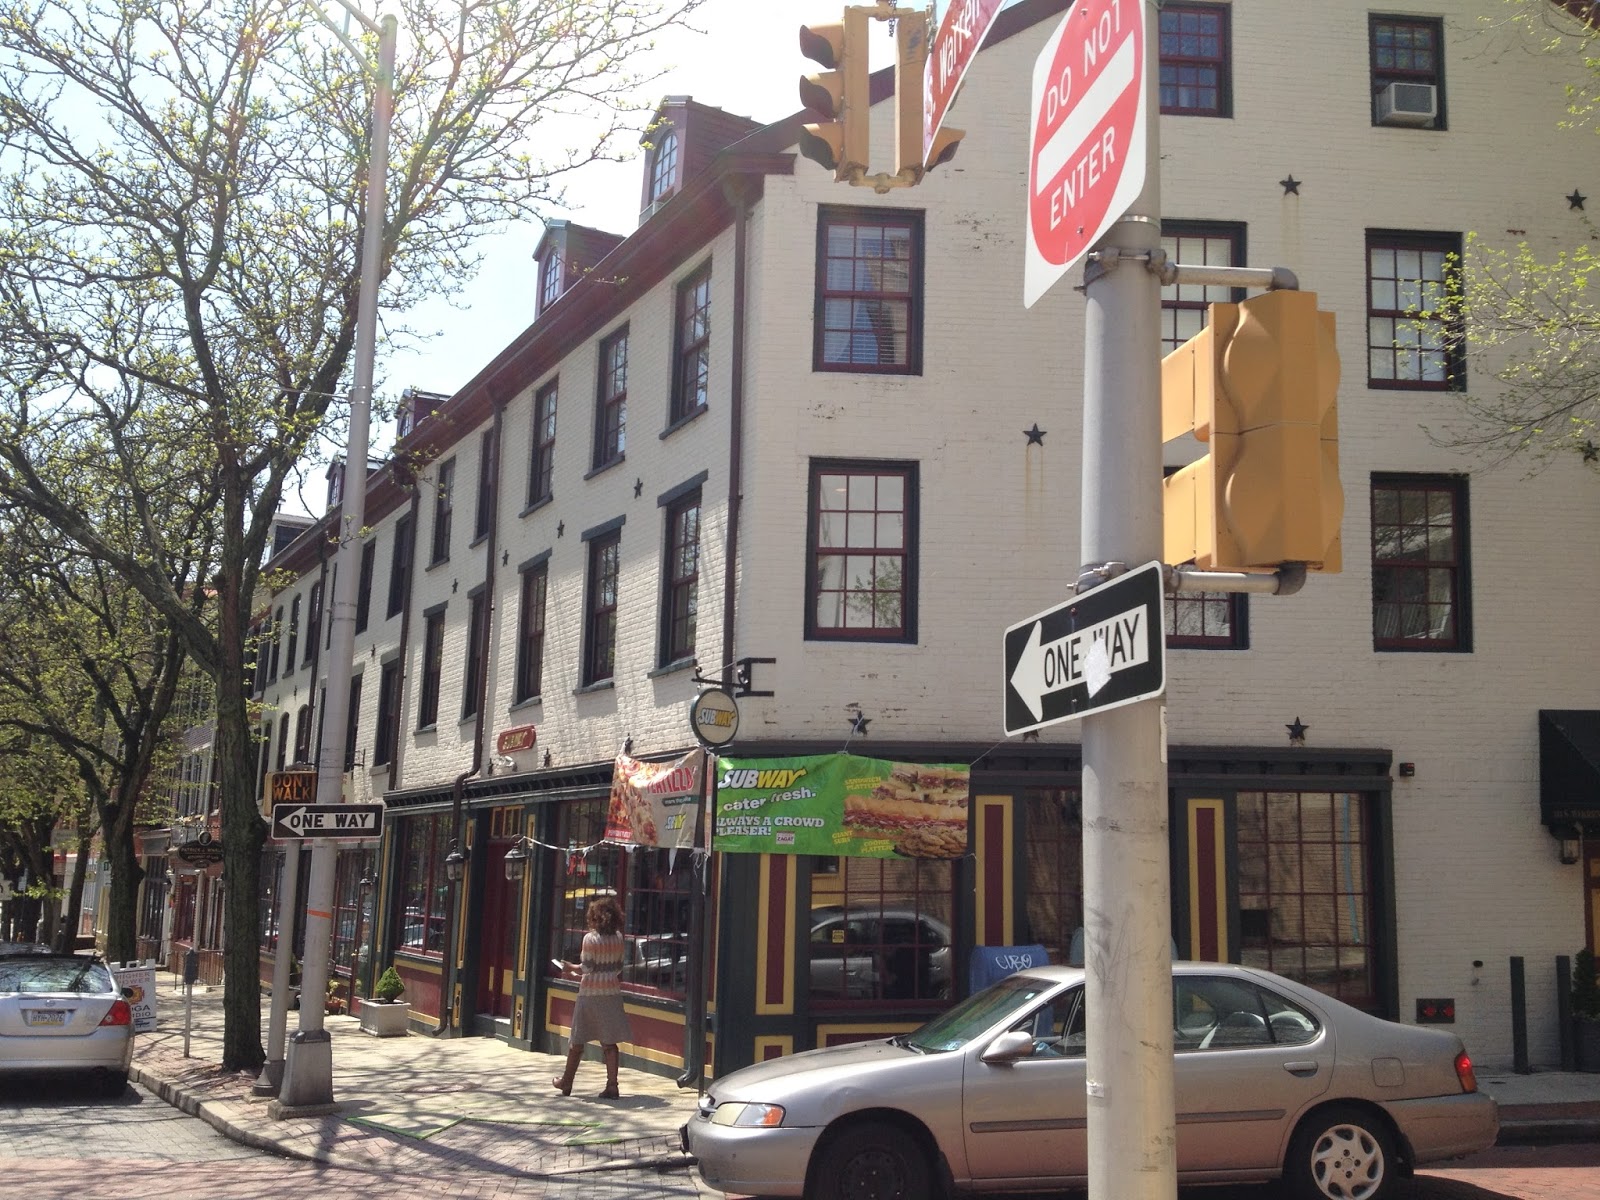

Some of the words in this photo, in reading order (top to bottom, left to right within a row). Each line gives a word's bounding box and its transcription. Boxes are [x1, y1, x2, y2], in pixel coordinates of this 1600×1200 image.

[1046, 66, 1072, 126] DO
[1084, 0, 1120, 77] NOT
[1050, 125, 1116, 232] ENTER
[1044, 636, 1082, 688] ONE
[698, 707, 736, 727] SUBWAY
[717, 766, 808, 789] SUBWAY
[273, 787, 310, 800] WALK
[723, 798, 766, 811] cater
[290, 814, 324, 828] ONE
[335, 814, 370, 828] WAY
[762, 816, 772, 826] A
[774, 816, 825, 828] CROWD
